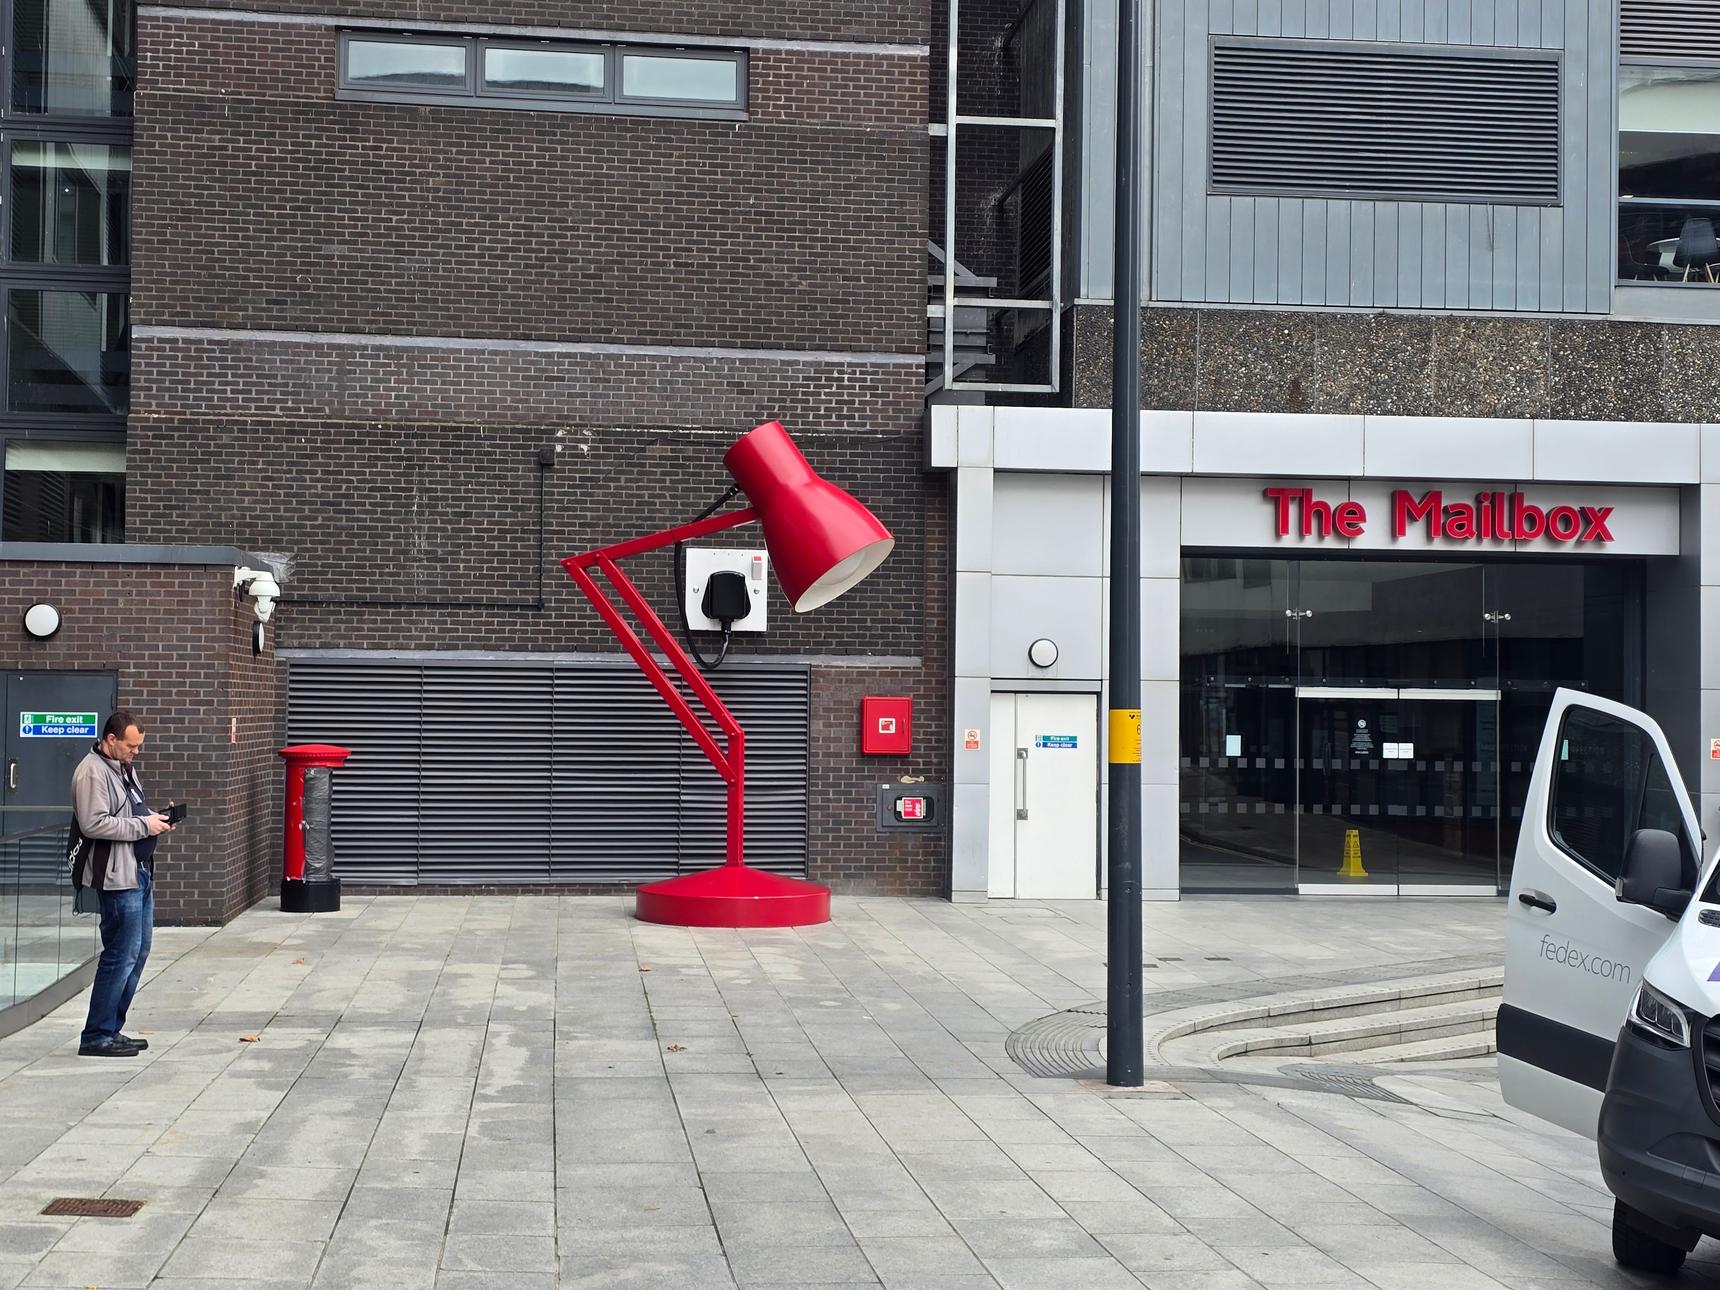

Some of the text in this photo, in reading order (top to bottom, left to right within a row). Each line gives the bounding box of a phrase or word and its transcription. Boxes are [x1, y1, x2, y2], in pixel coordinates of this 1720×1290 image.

[1264, 487, 1616, 543] The Mailbox
[41, 725, 89, 735] Keep clear
[46, 715, 84, 724] Fire exit
[1540, 934, 1631, 984] fedex.com
